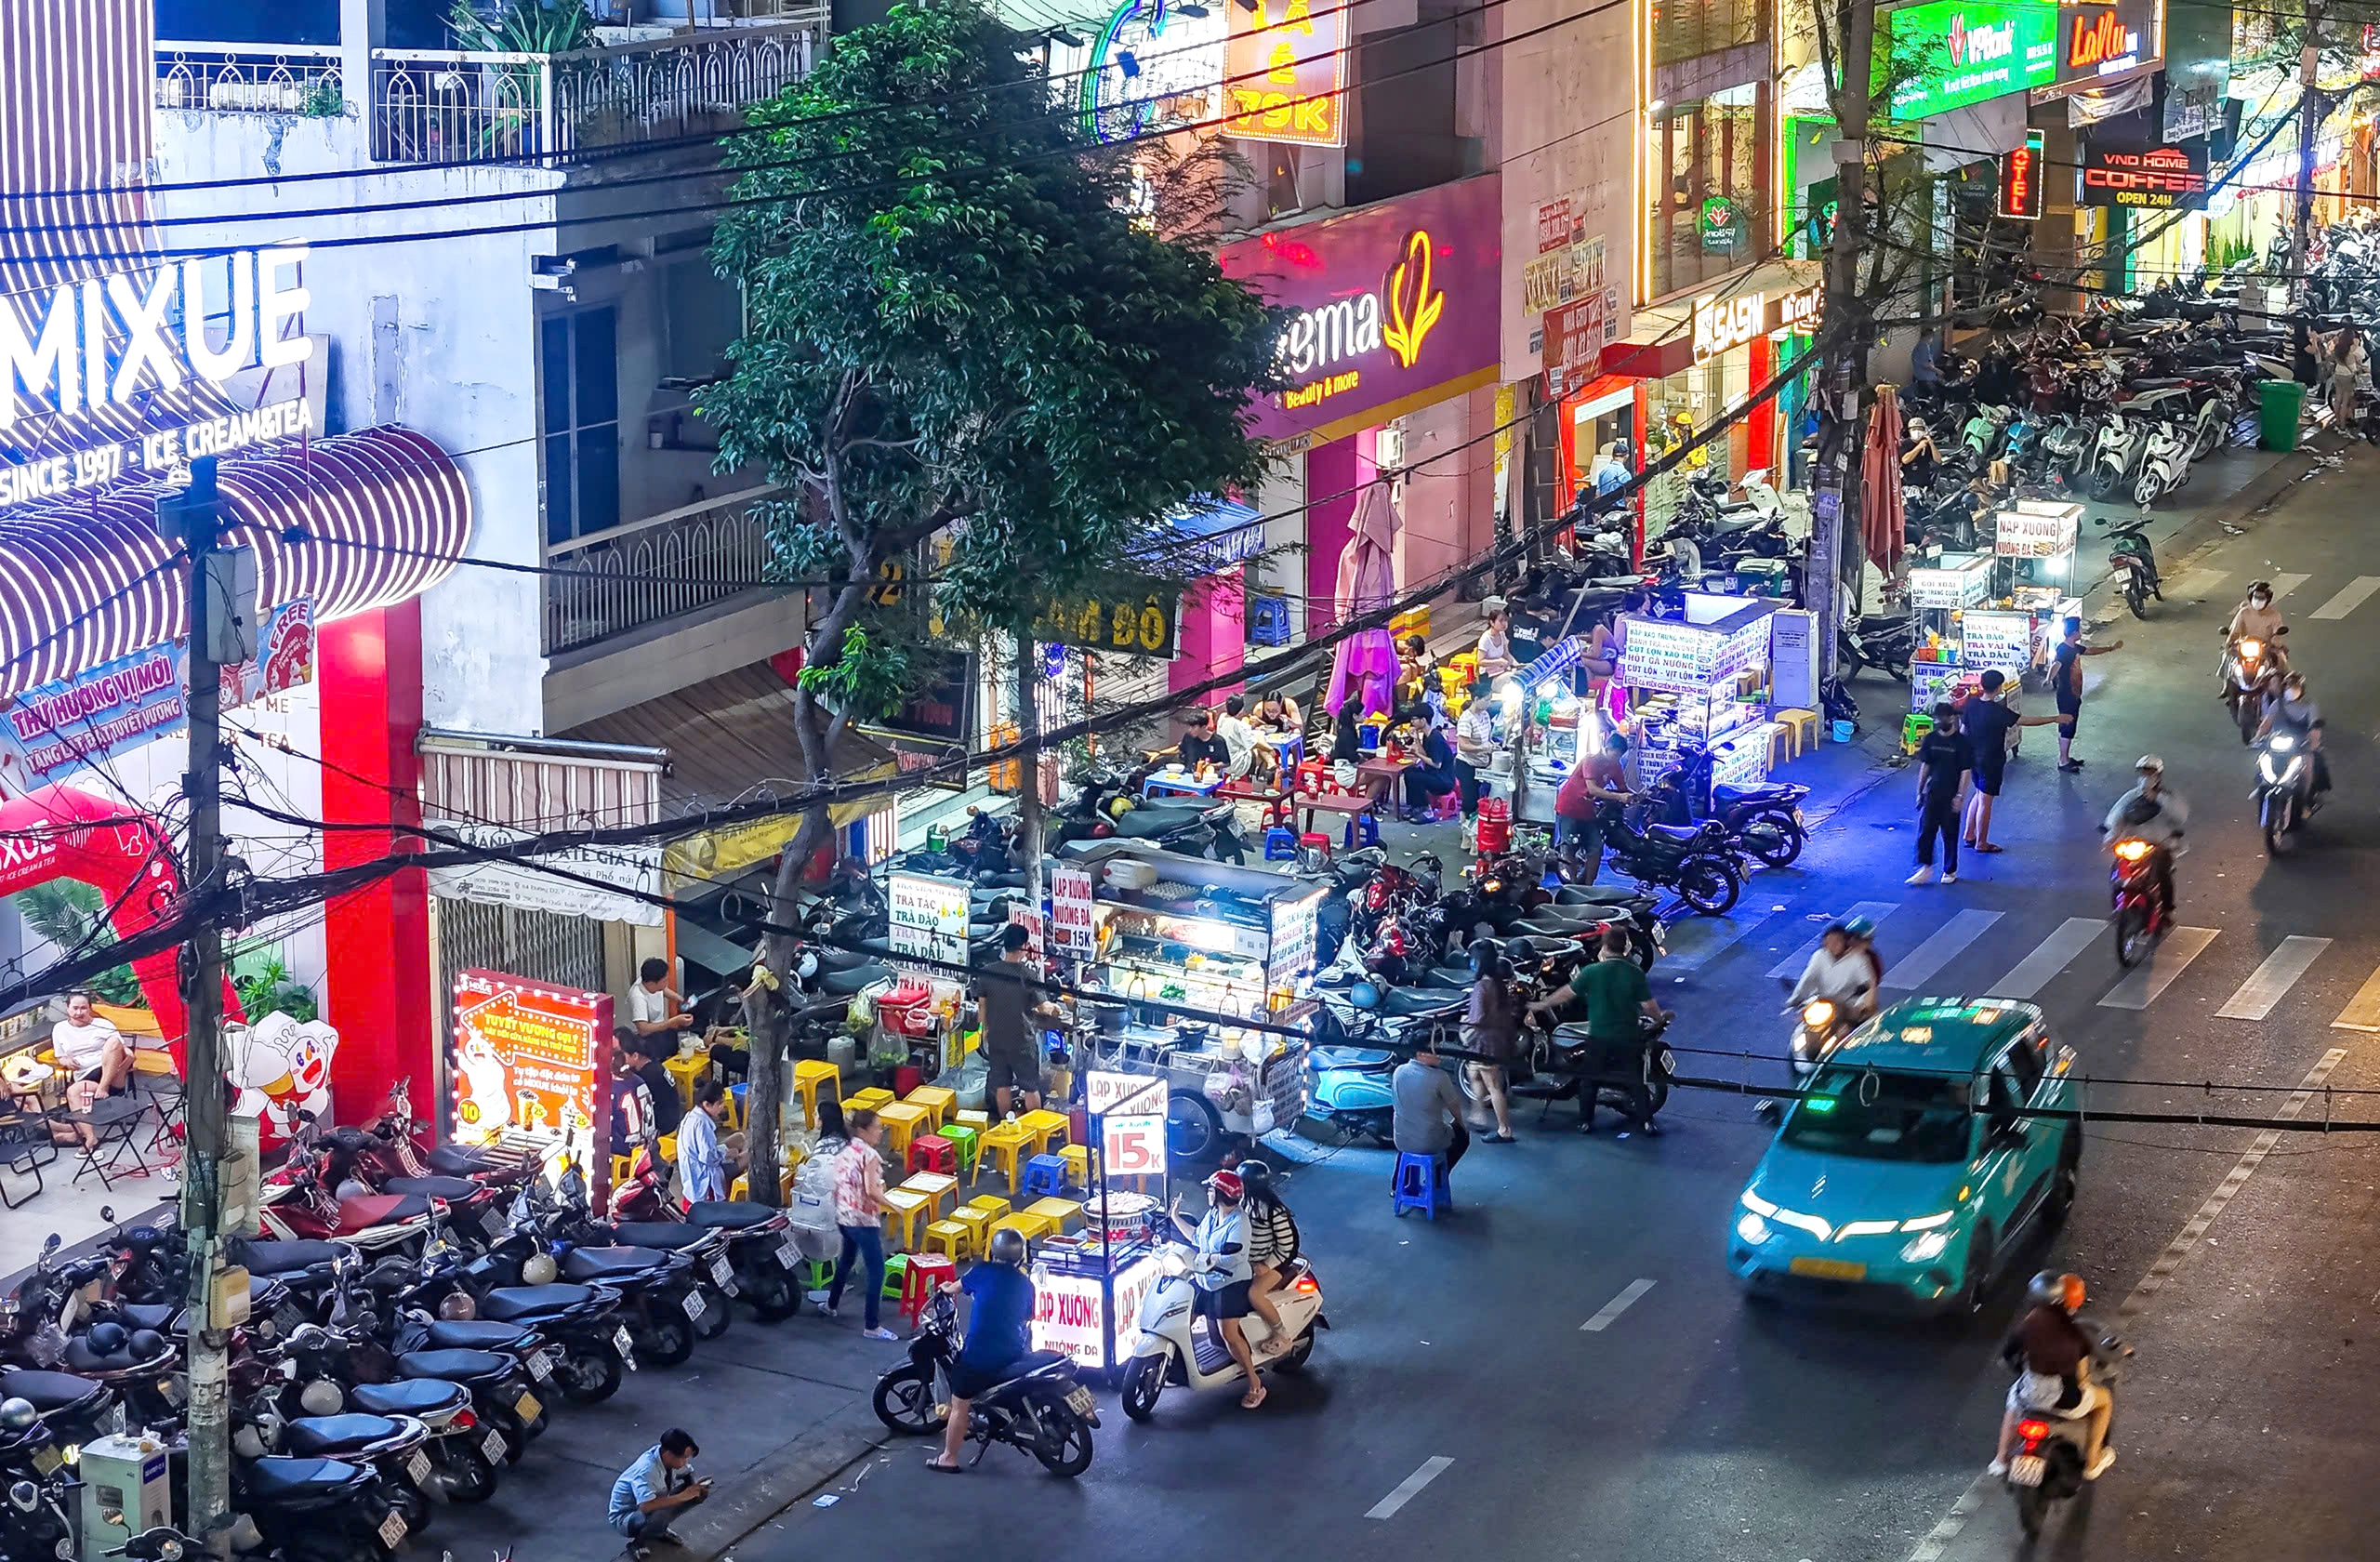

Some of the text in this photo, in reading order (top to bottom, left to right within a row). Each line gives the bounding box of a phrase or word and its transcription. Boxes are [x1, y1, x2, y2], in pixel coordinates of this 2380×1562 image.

[1966, 20, 2015, 64] VPBank
[1233, 89, 1329, 132] 79K
[2143, 156, 2188, 169] HOME
[2011, 148, 2031, 213] OTEL
[2085, 169, 2206, 192] COFFEE
[2117, 192, 2173, 205] OPEN 24H
[0, 236, 314, 430] MIXUE
[1324, 377, 1332, 397] &
[1333, 370, 1359, 393] more
[0, 457, 69, 503] SINCE
[74, 443, 121, 487] 1997
[143, 430, 179, 471] ICE
[269, 602, 310, 650] FREE
[11, 655, 174, 737] THỬ HƯƠNG VỊ MỚI
[266, 698, 289, 713] ME
[141, 697, 181, 727] VƯƠNG
[259, 732, 289, 748] TEA
[0, 819, 56, 869] XUE
[44, 856, 55, 866] TEA
[597, 849, 626, 867] GIA
[596, 870, 633, 883] Phố núi
[1072, 930, 1091, 947] 15K
[483, 1013, 517, 1031] TUYẾT
[518, 1020, 556, 1039] VƯƠNG
[460, 1104, 480, 1121] 10
[534, 1106, 543, 1116] 25
[576, 1118, 586, 1127] 25
